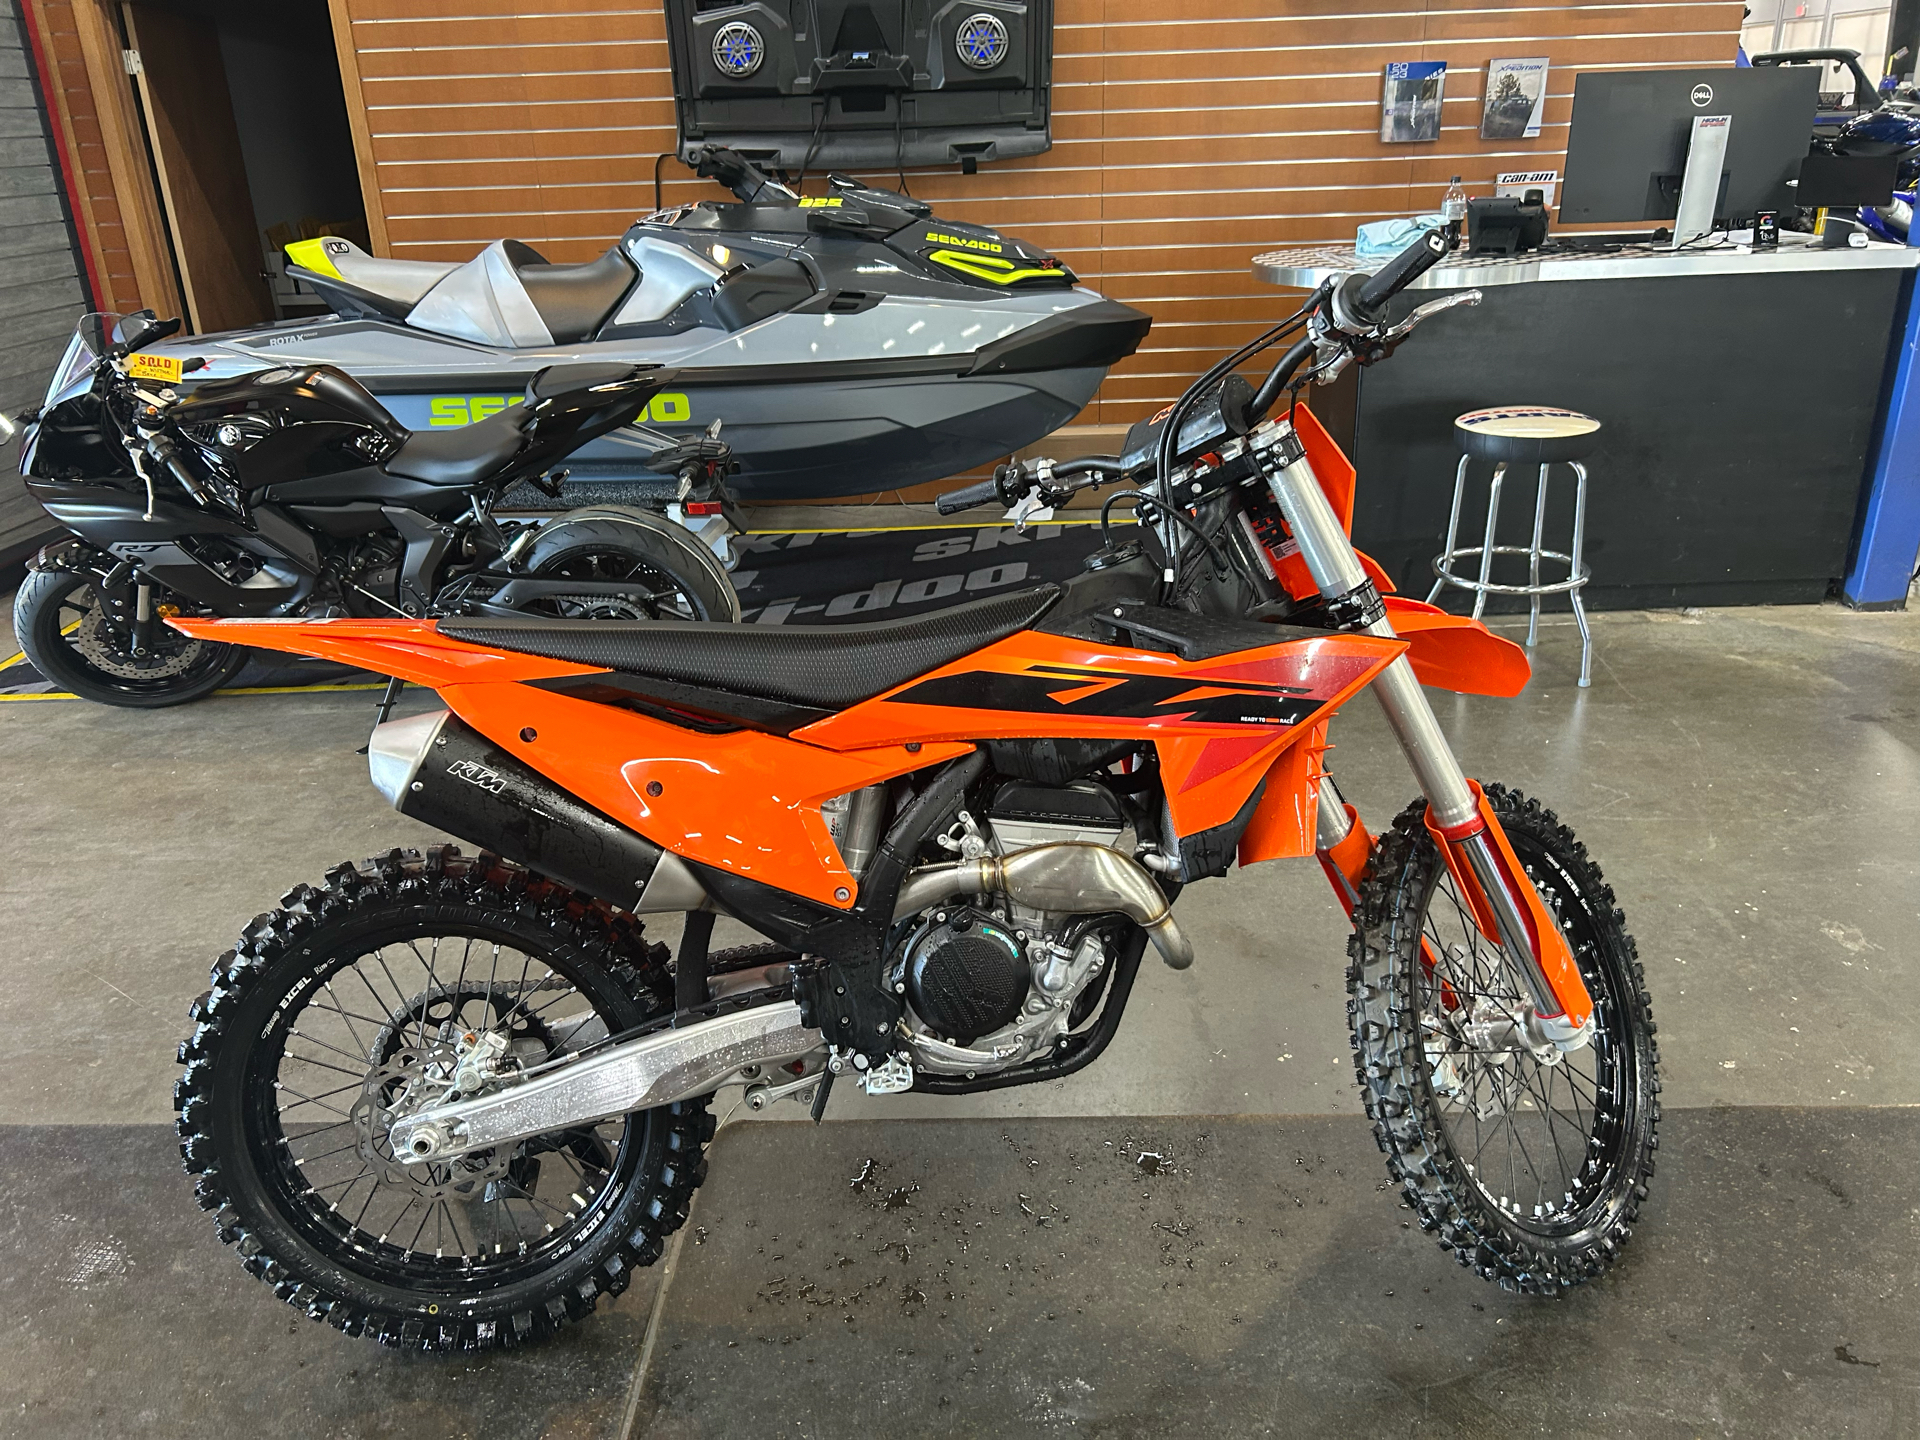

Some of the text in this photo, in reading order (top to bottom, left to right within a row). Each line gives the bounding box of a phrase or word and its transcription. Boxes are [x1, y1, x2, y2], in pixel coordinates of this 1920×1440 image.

[1502, 173, 1554, 184] can-am
[269, 334, 304, 347] ROTAX
[139, 356, 171, 368] SOLD
[446, 760, 507, 794] KTM
[278, 976, 312, 1010] EXCEL
[313, 957, 336, 975] Rim
[574, 1210, 606, 1242] EXCEL
